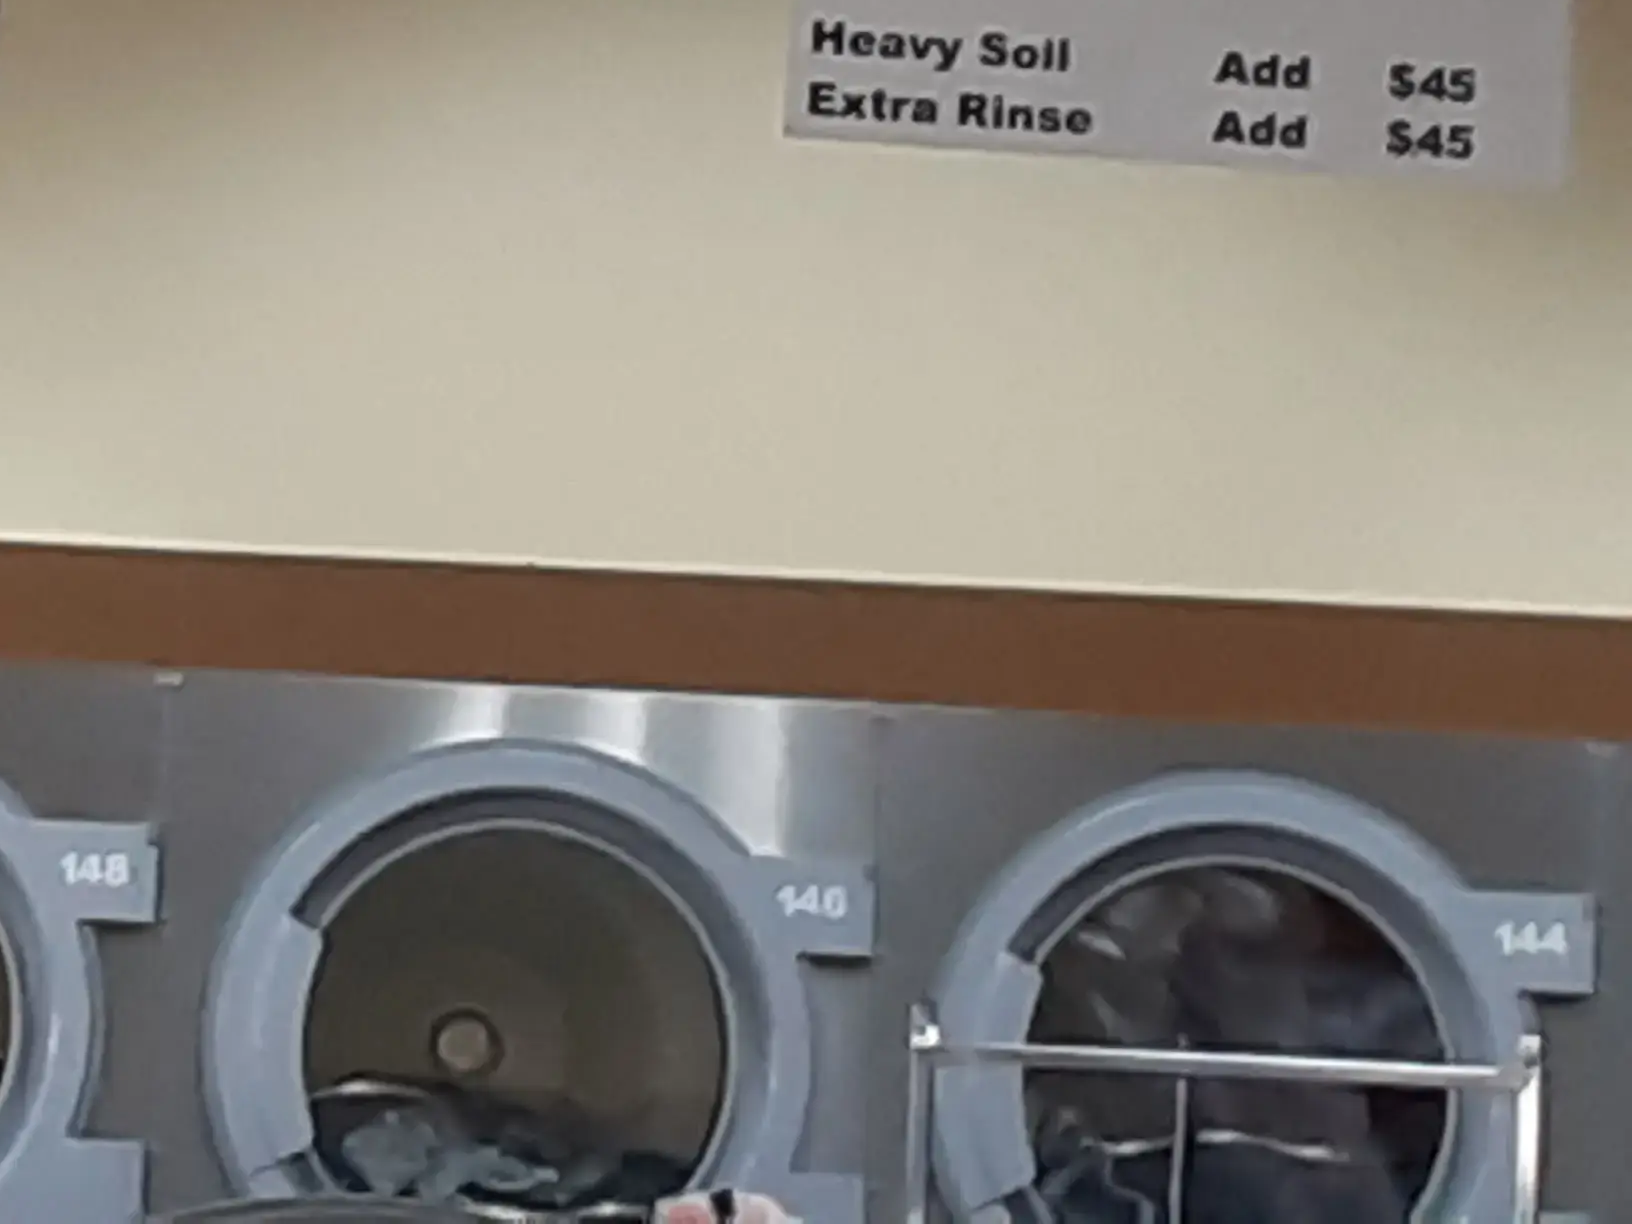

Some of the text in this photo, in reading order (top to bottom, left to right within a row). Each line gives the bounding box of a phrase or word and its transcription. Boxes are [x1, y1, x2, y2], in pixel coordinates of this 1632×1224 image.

[811, 18, 963, 71] Heavy
[979, 32, 1070, 72] Soil
[1214, 50, 1311, 90] Add
[807, 81, 937, 127] Extra
[958, 91, 1094, 136] Rinse
[1212, 110, 1308, 149] Add
[59, 851, 130, 888] 148
[1494, 920, 1570, 956] 144
